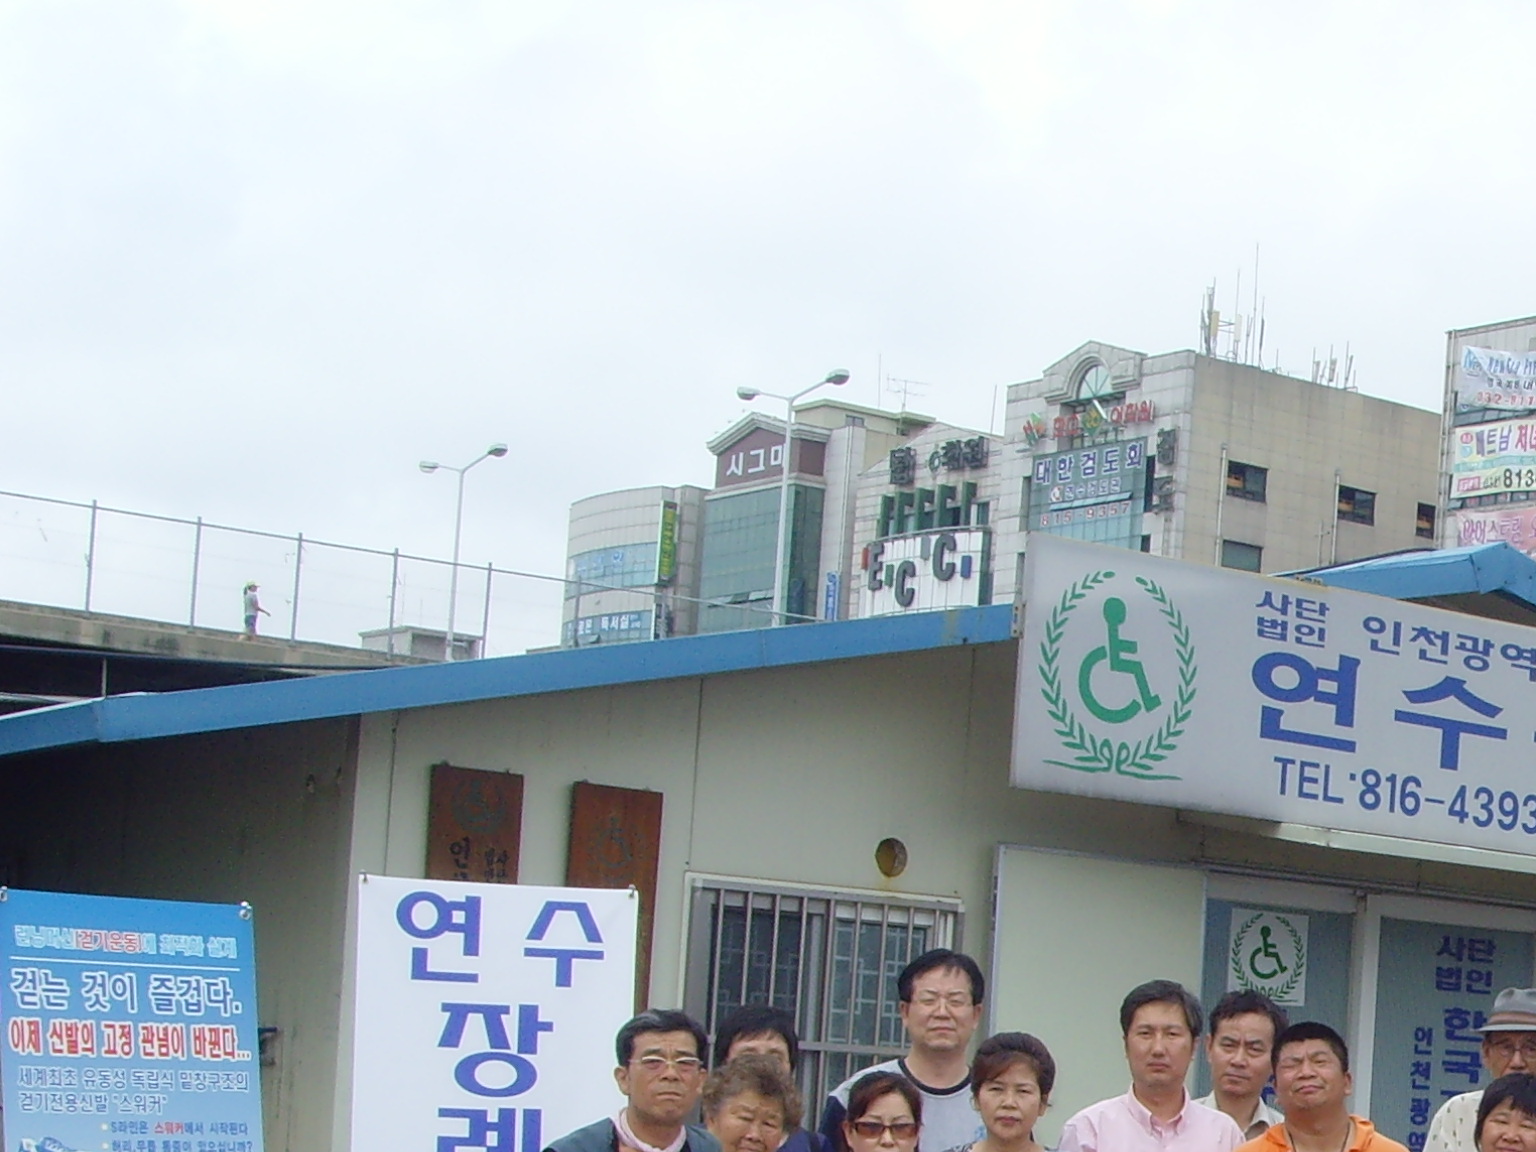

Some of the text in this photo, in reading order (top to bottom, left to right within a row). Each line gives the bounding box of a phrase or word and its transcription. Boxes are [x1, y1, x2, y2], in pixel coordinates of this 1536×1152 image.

[1035, 442, 1143, 484] 대한검도회
[1041, 501, 1131, 528] 815-9357
[1255, 589, 1331, 624] 사단
[1255, 616, 1327, 649] 법인
[1436, 935, 1497, 965] 사단
[11, 967, 242, 1016] 걷는 것이 즐겁다.
[1435, 966, 1494, 995] 법인
[9, 1017, 43, 1054] 이제
[48, 1018, 97, 1057] 신발의
[101, 1021, 134, 1058] 고정
[139, 1023, 187, 1060] 관념이
[18, 1066, 78, 1089] 세계최초
[83, 1069, 128, 1090] 유동성
[131, 1070, 175, 1091] 독립식
[19, 1092, 108, 1114] 걷기전용신발
